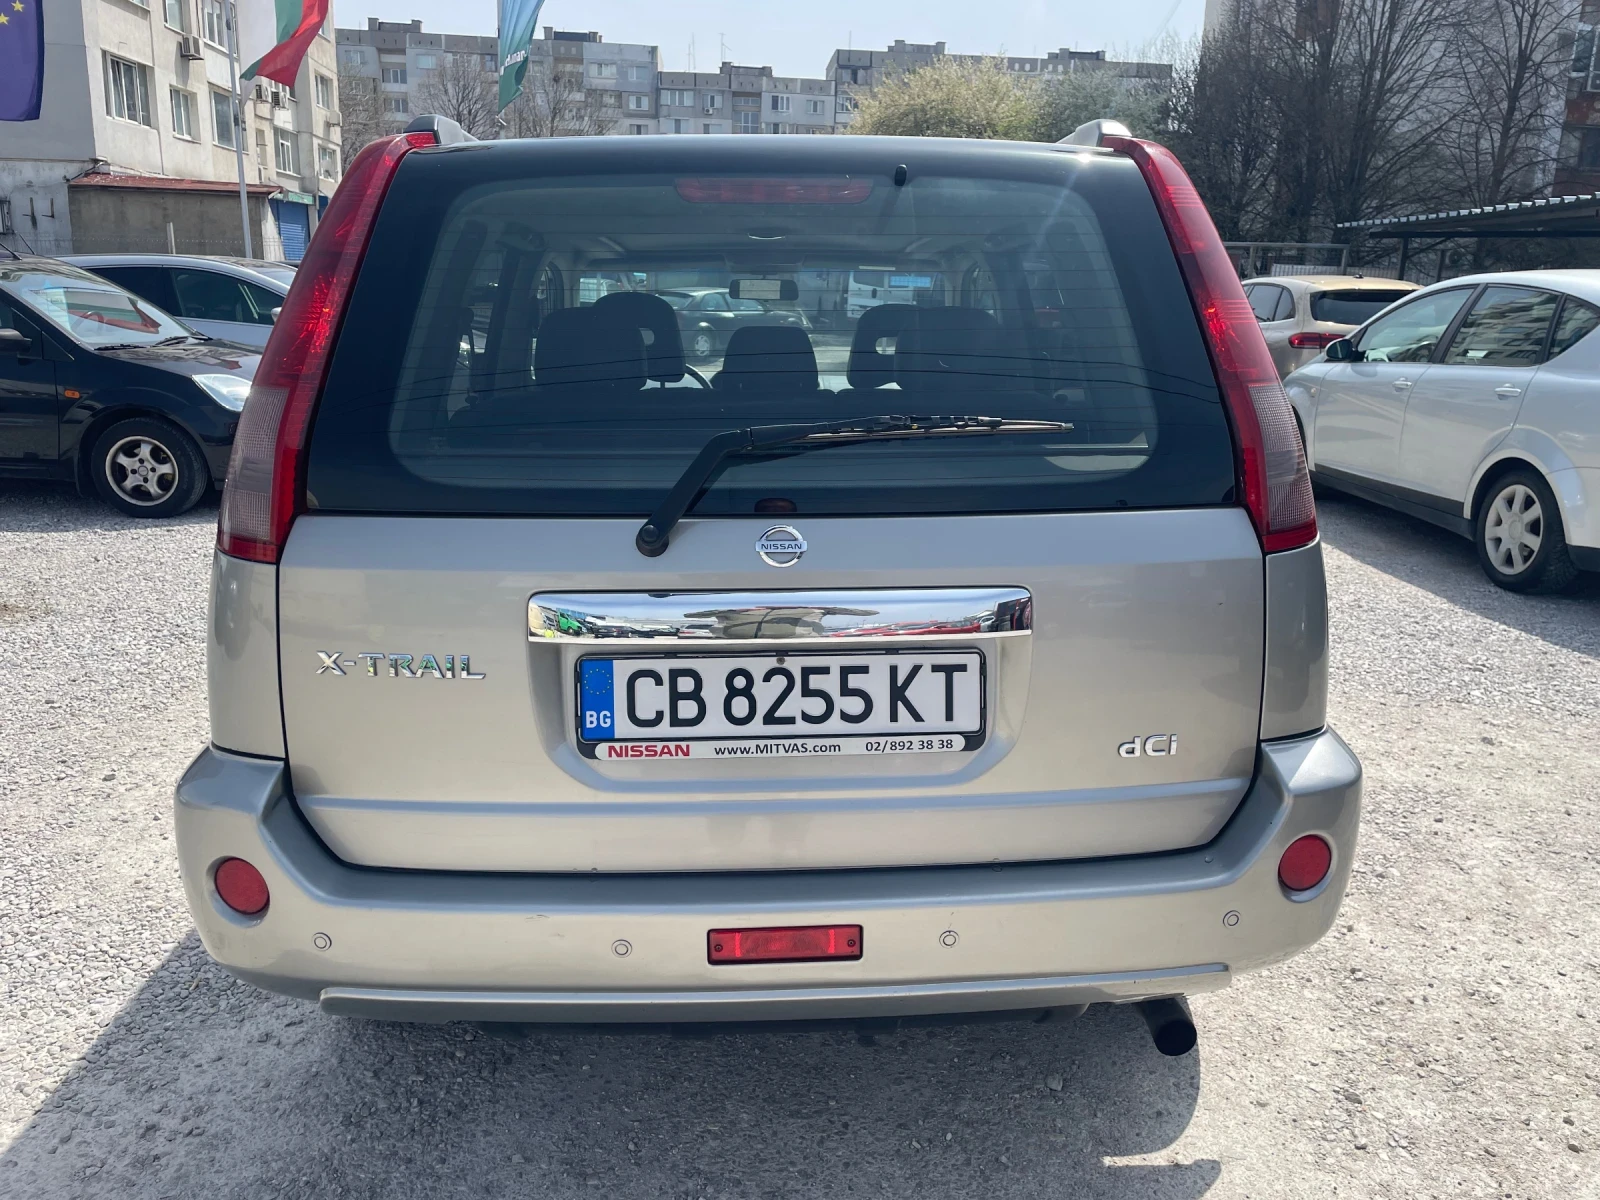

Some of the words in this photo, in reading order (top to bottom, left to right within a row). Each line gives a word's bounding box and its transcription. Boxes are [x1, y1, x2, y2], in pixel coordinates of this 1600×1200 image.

[315, 650, 486, 680] X-TRAIL
[626, 668, 707, 728] CB
[723, 665, 874, 726] 8255
[889, 664, 968, 723] KT
[585, 711, 611, 729] BG
[607, 744, 690, 758] NISSAN
[714, 742, 841, 755] www.MITVAS.com
[917, 739, 934, 750] 38
[937, 738, 953, 749] 38
[1118, 733, 1178, 758] dCi
